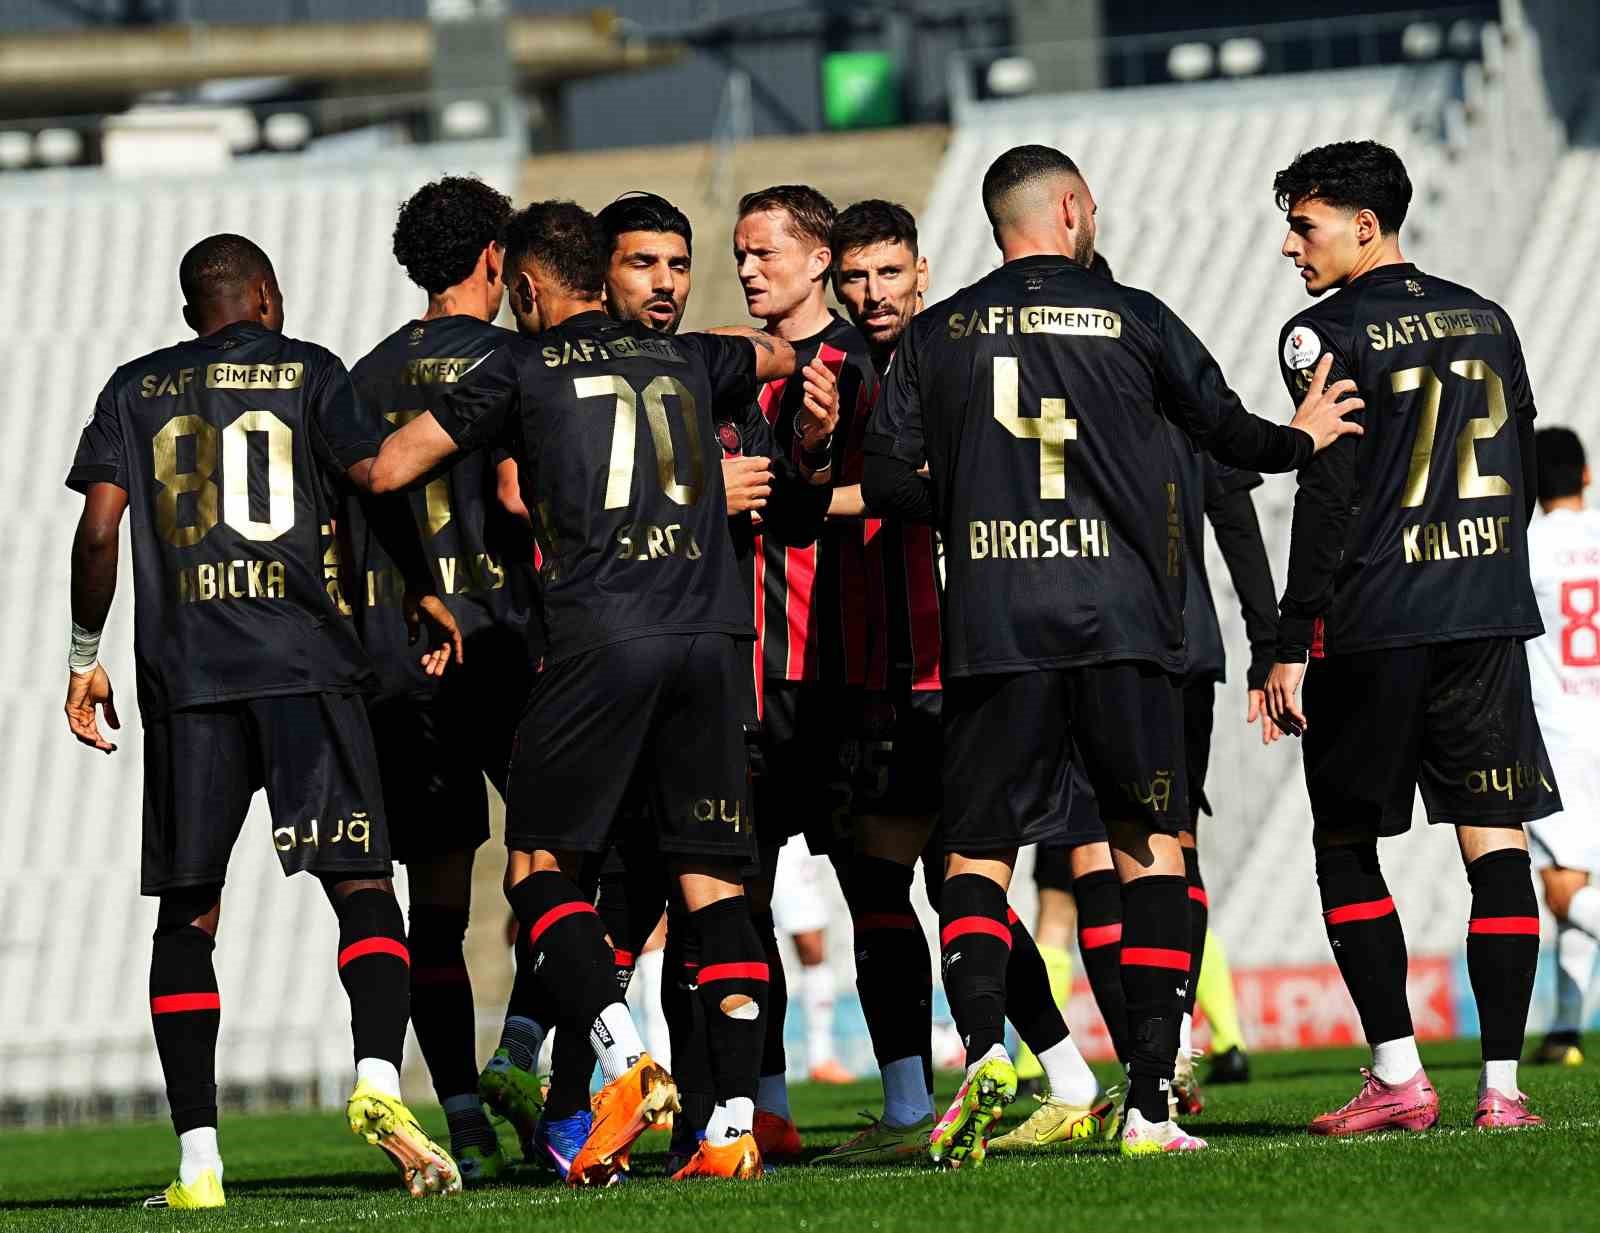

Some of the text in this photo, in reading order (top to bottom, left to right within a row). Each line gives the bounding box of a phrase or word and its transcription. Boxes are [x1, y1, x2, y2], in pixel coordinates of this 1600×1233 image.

[141, 365, 296, 398] SAF ÇİMENTO
[1027, 307, 1115, 330] ÇİMENTO
[153, 410, 295, 547] 80
[573, 376, 701, 510] 70
[993, 356, 1077, 500] 4
[1391, 359, 1512, 508] 72
[969, 519, 1110, 560] BIRASCHI
